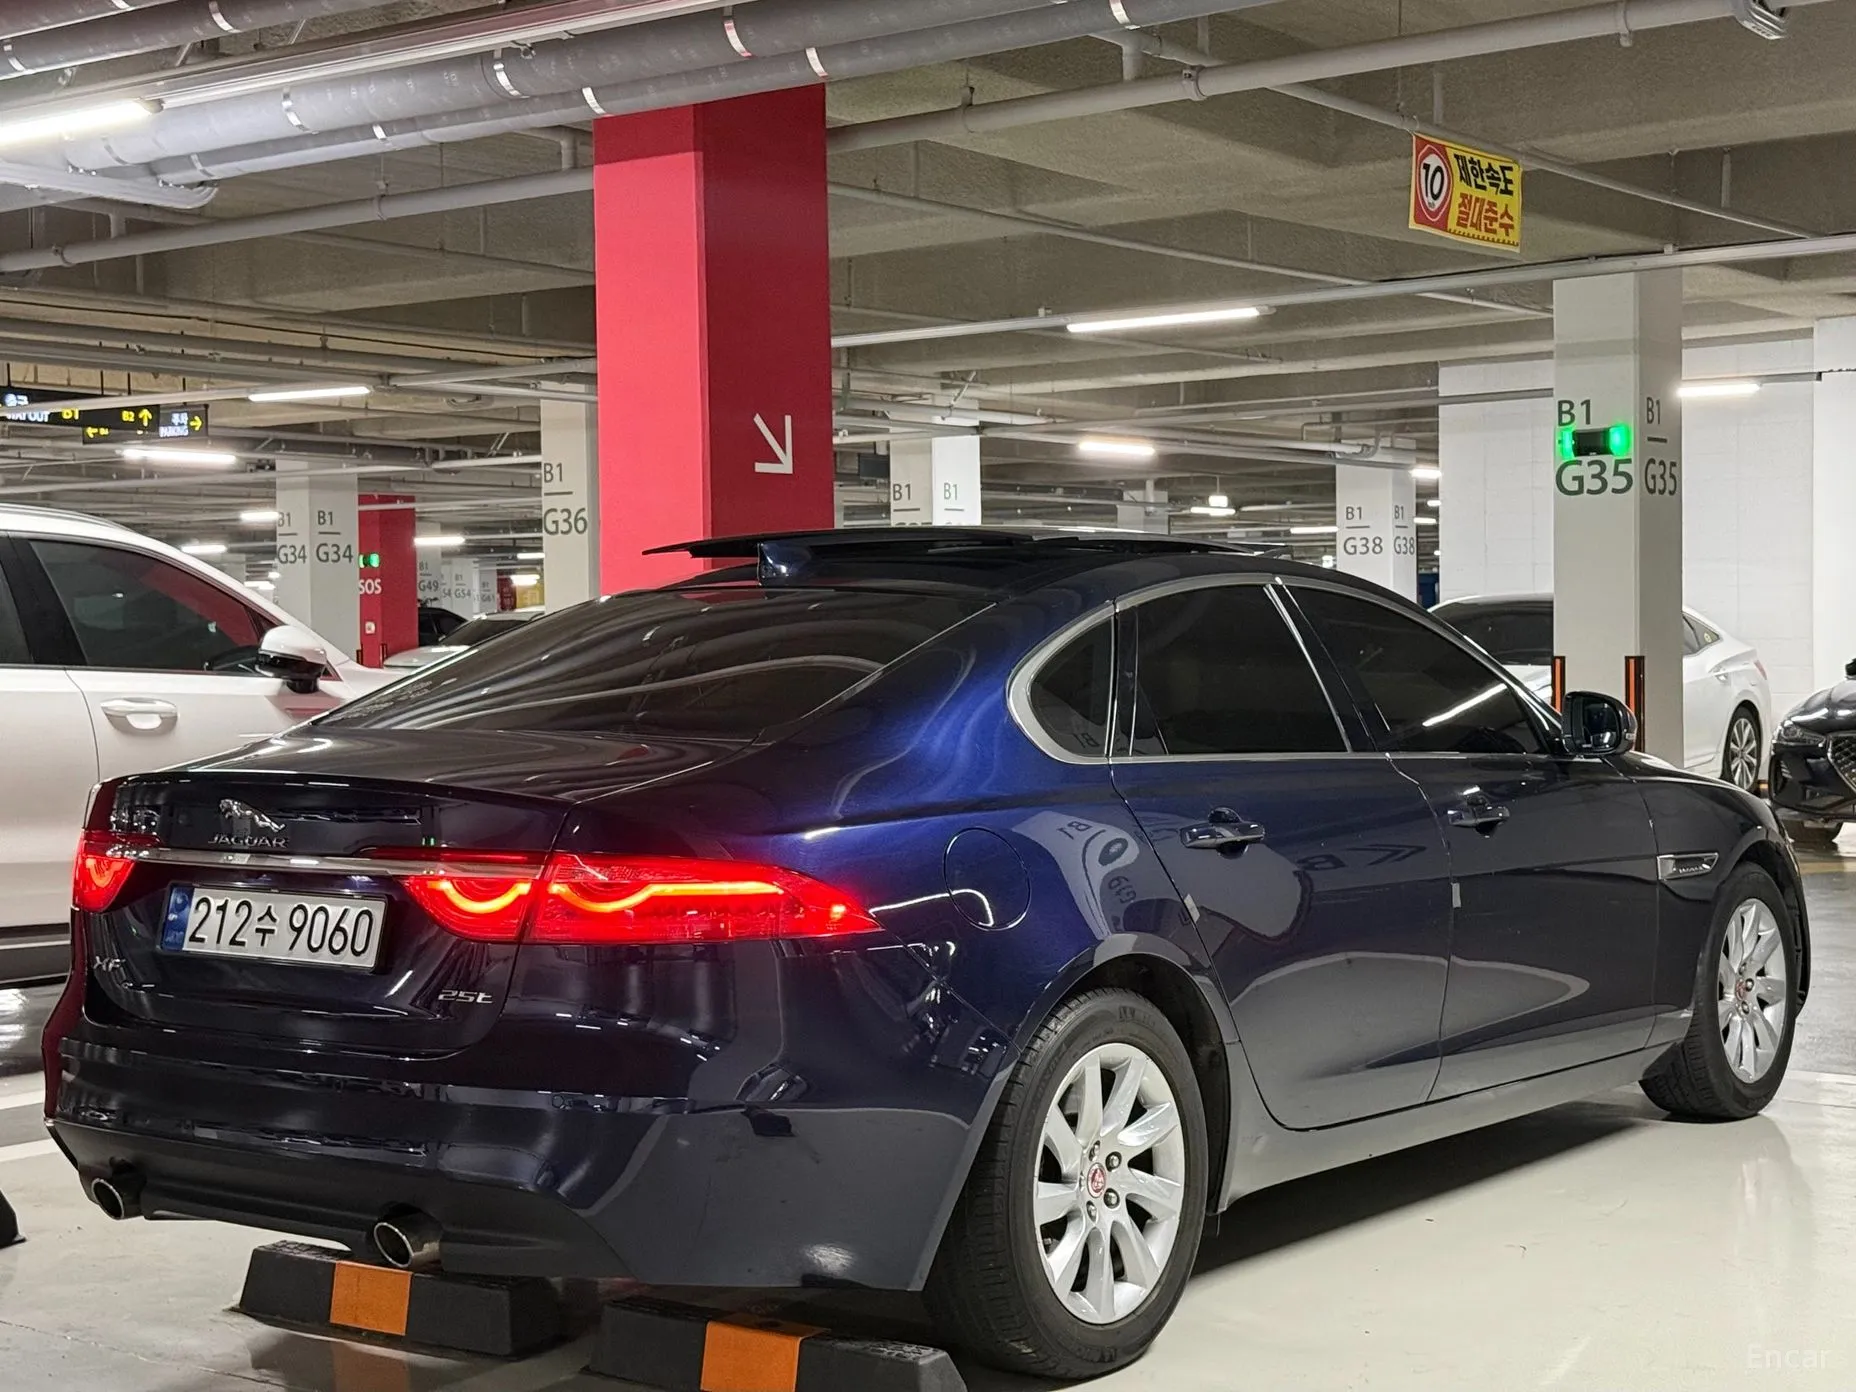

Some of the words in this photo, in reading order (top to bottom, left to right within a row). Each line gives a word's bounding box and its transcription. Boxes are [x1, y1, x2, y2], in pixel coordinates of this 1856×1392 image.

[1423, 162, 1445, 201] 10
[1454, 153, 1514, 197] 제한속도
[1456, 192, 1515, 237] 절대준수
[121, 410, 135, 422] B2
[1558, 399, 1592, 427] B1
[1646, 397, 1661, 425] B1
[543, 462, 563, 483] B1
[1555, 458, 1634, 496] G35
[1644, 458, 1678, 496] G35
[893, 483, 911, 501] B1
[943, 482, 958, 501] B1
[317, 510, 334, 526] B1
[543, 507, 588, 536] G36
[1345, 506, 1363, 521] B1
[1394, 504, 1405, 520] B1
[277, 544, 307, 564] G34
[316, 543, 354, 564] G34
[1343, 536, 1384, 556] G38
[1393, 536, 1416, 556] G38
[358, 578, 383, 595] SOS
[418, 579, 440, 592] G49
[207, 833, 290, 848] JAGUAR
[188, 896, 278, 948] 212수
[288, 903, 374, 957] 9060
[438, 989, 493, 1004] 25t
